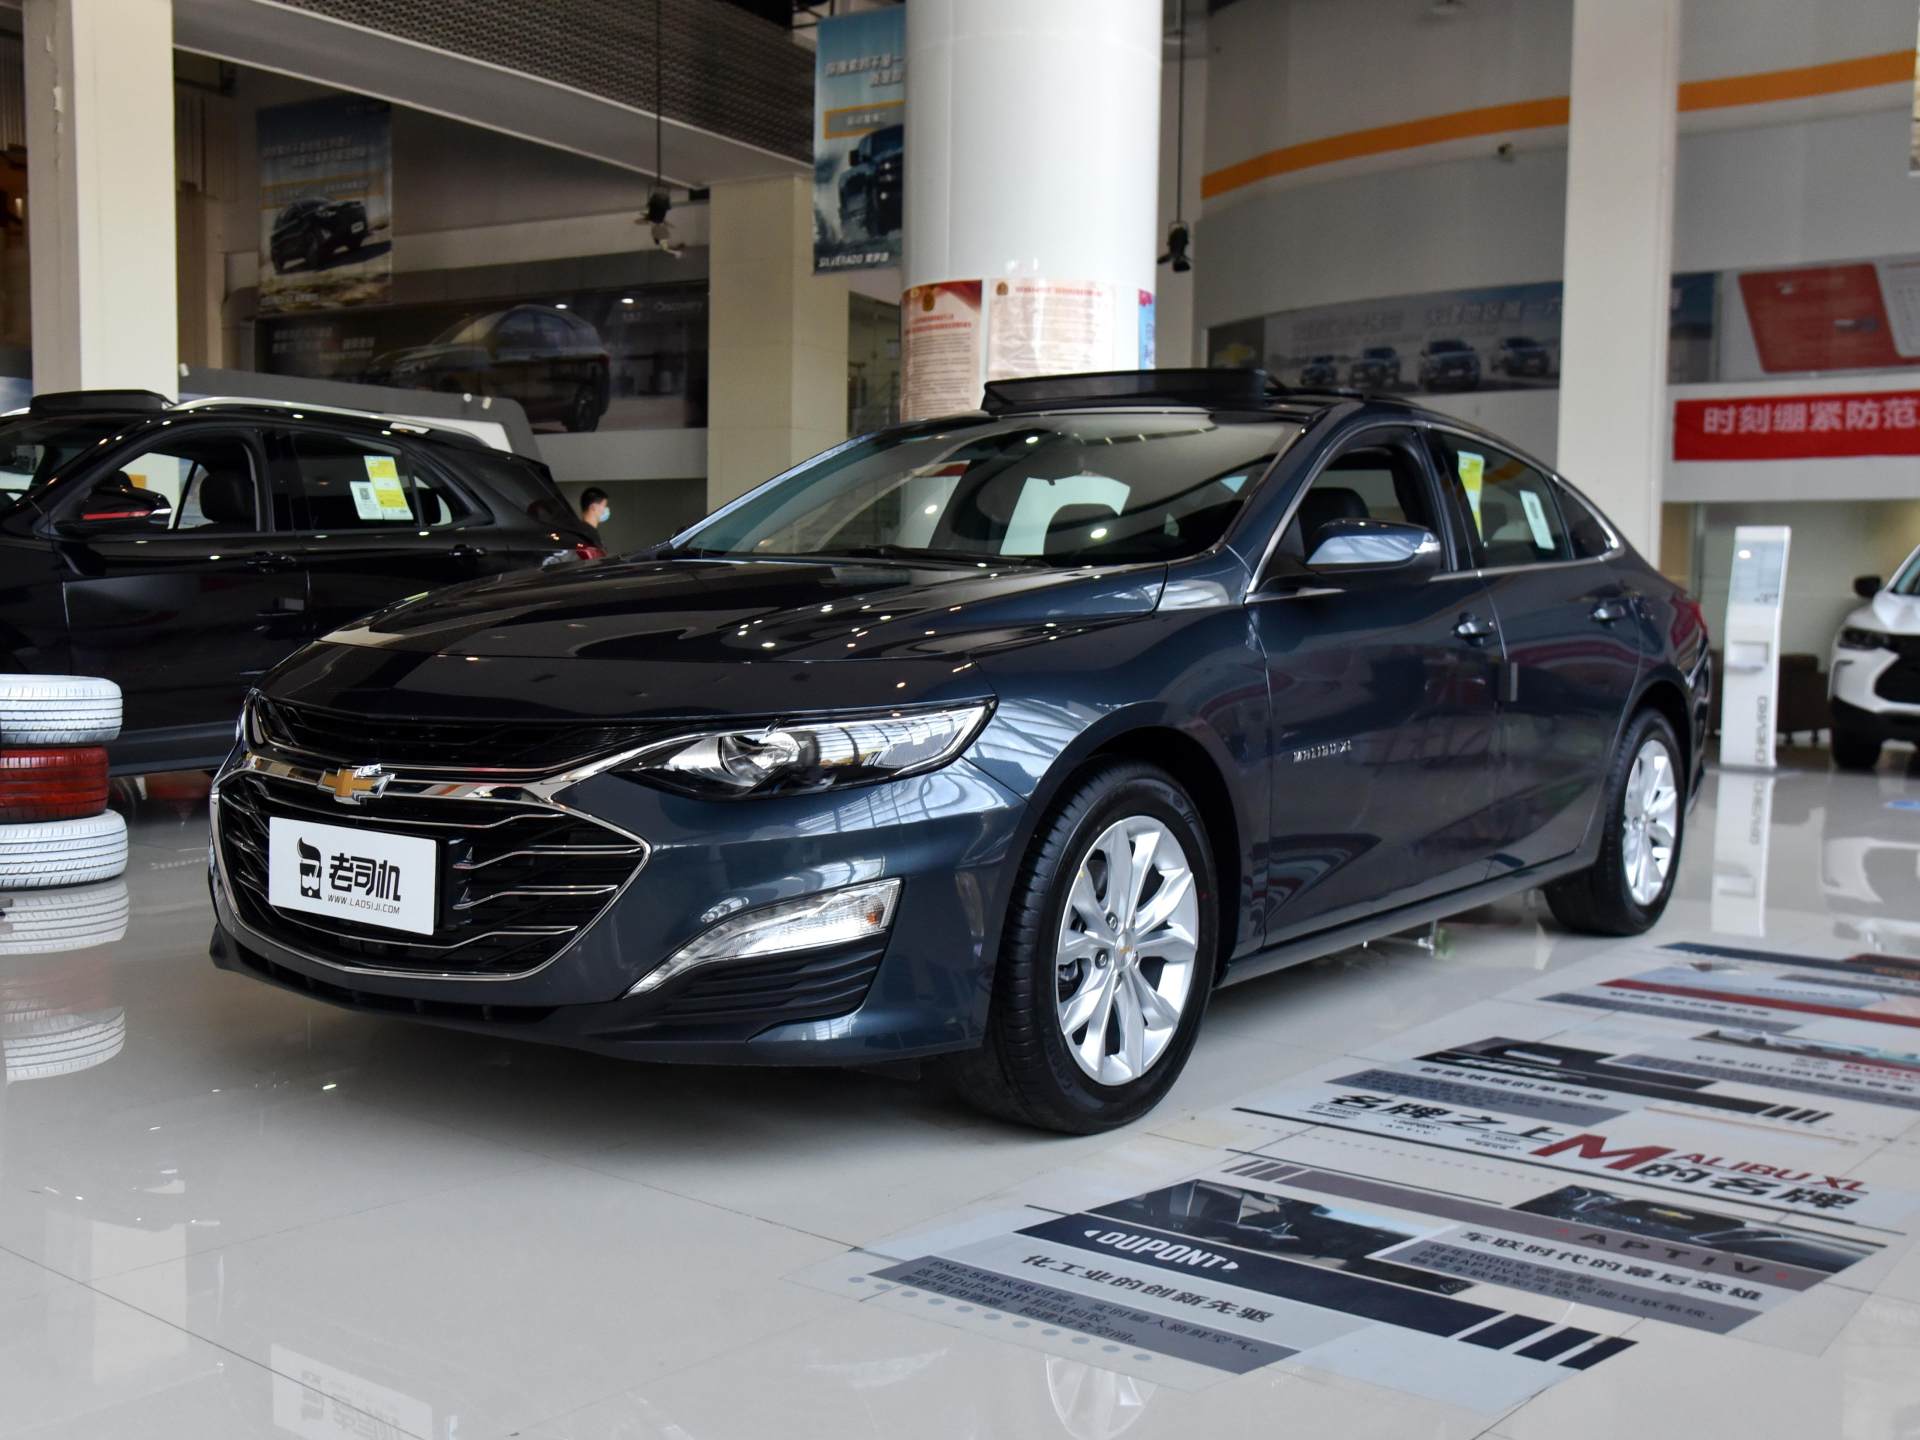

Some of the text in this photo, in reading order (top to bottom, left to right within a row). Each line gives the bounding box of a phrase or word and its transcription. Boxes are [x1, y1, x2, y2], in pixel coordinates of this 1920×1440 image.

[1703, 397, 1919, 434] 时刻绷紧防范
[329, 852, 401, 902] 老司机
[328, 894, 400, 914] WWW.LAOSIJI.COM
[1329, 1094, 1564, 1143] 名牌之上
[1634, 1163, 1859, 1211] 的名牌
[1819, 1174, 1870, 1194] XL
[1097, 1230, 1225, 1270] DUPONT
[1459, 1229, 1764, 1302] 车联时代的幕后英雄
[1579, 1230, 1764, 1274] APTIV
[1021, 1253, 1275, 1324] 化工业的创新先驱
